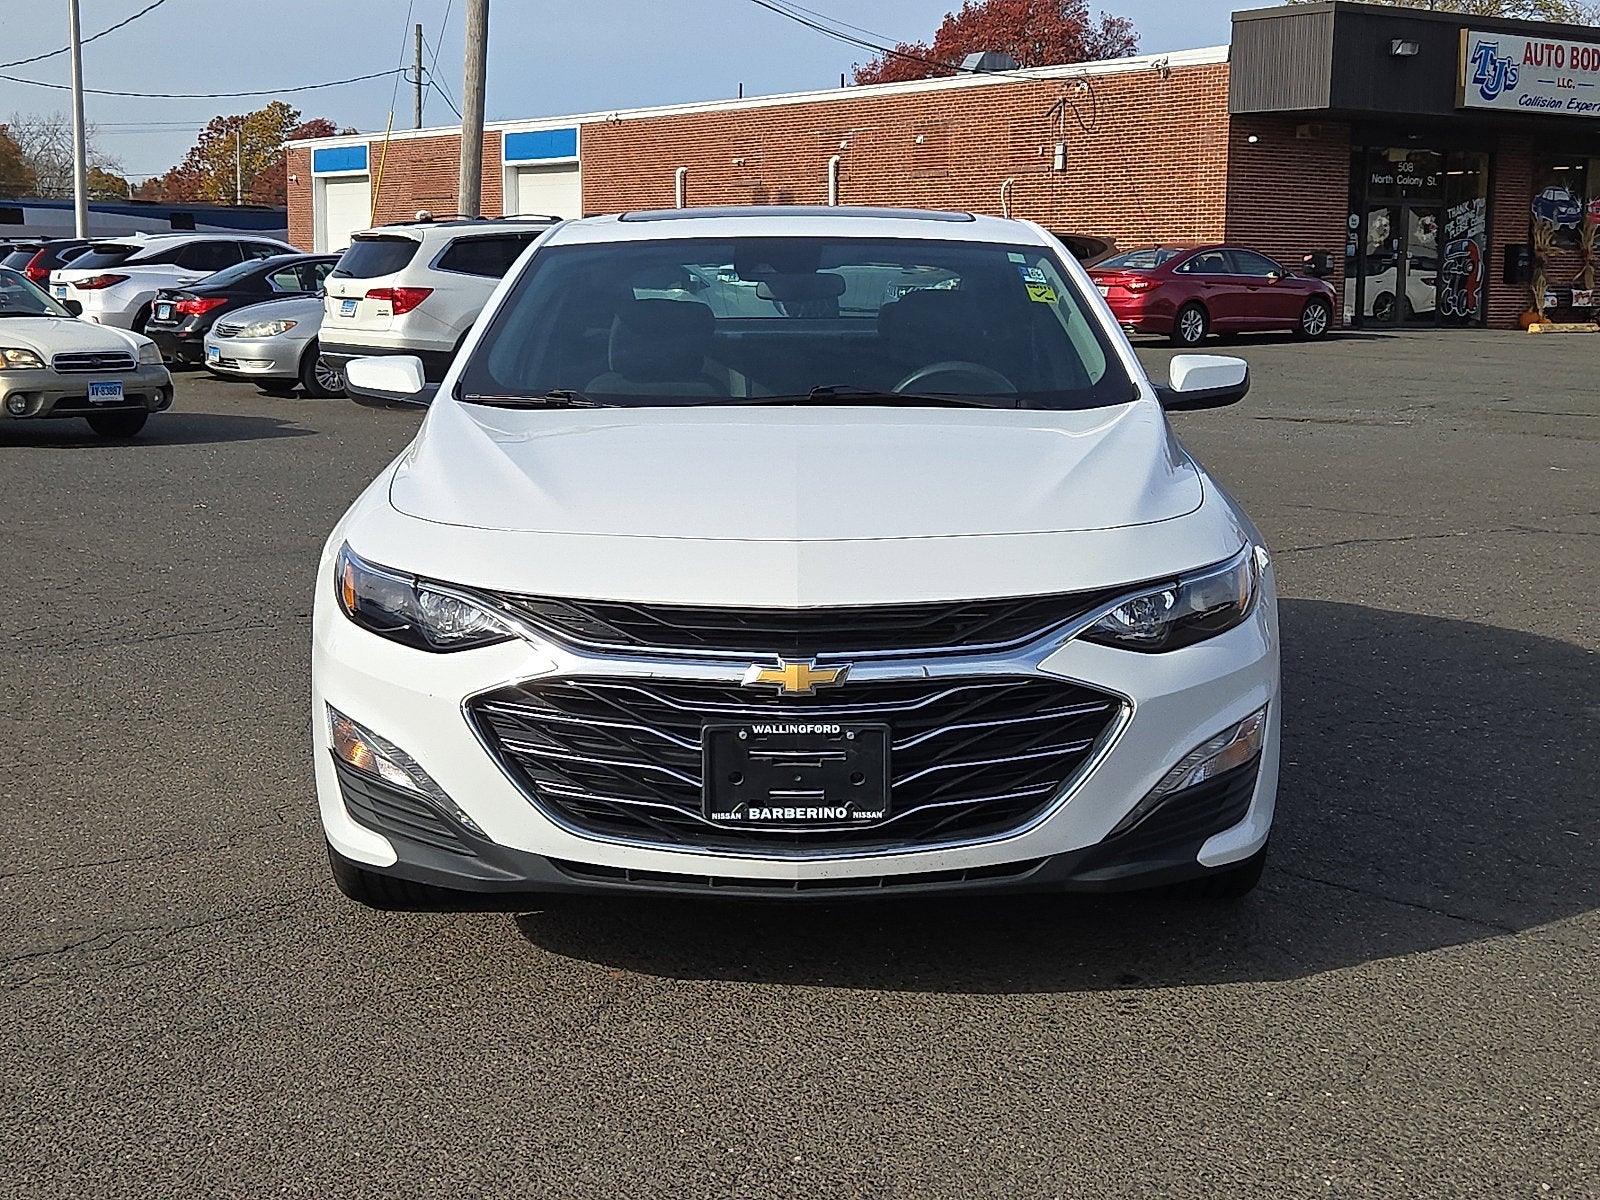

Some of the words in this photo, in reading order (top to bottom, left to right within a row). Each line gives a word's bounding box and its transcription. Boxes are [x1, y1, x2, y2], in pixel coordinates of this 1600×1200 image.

[1523, 42, 1565, 68] AUTO
[1470, 40, 1520, 100] TJ's
[1519, 94, 1562, 109] Collision
[1397, 162, 1414, 173] 508
[1371, 173, 1394, 184] North
[1396, 174, 1423, 188] Colony
[752, 724, 840, 734] WALLINGFORD
[711, 812, 742, 820] NISSAN
[749, 807, 847, 820] BARBERINO
[852, 811, 883, 819] NISSAN
